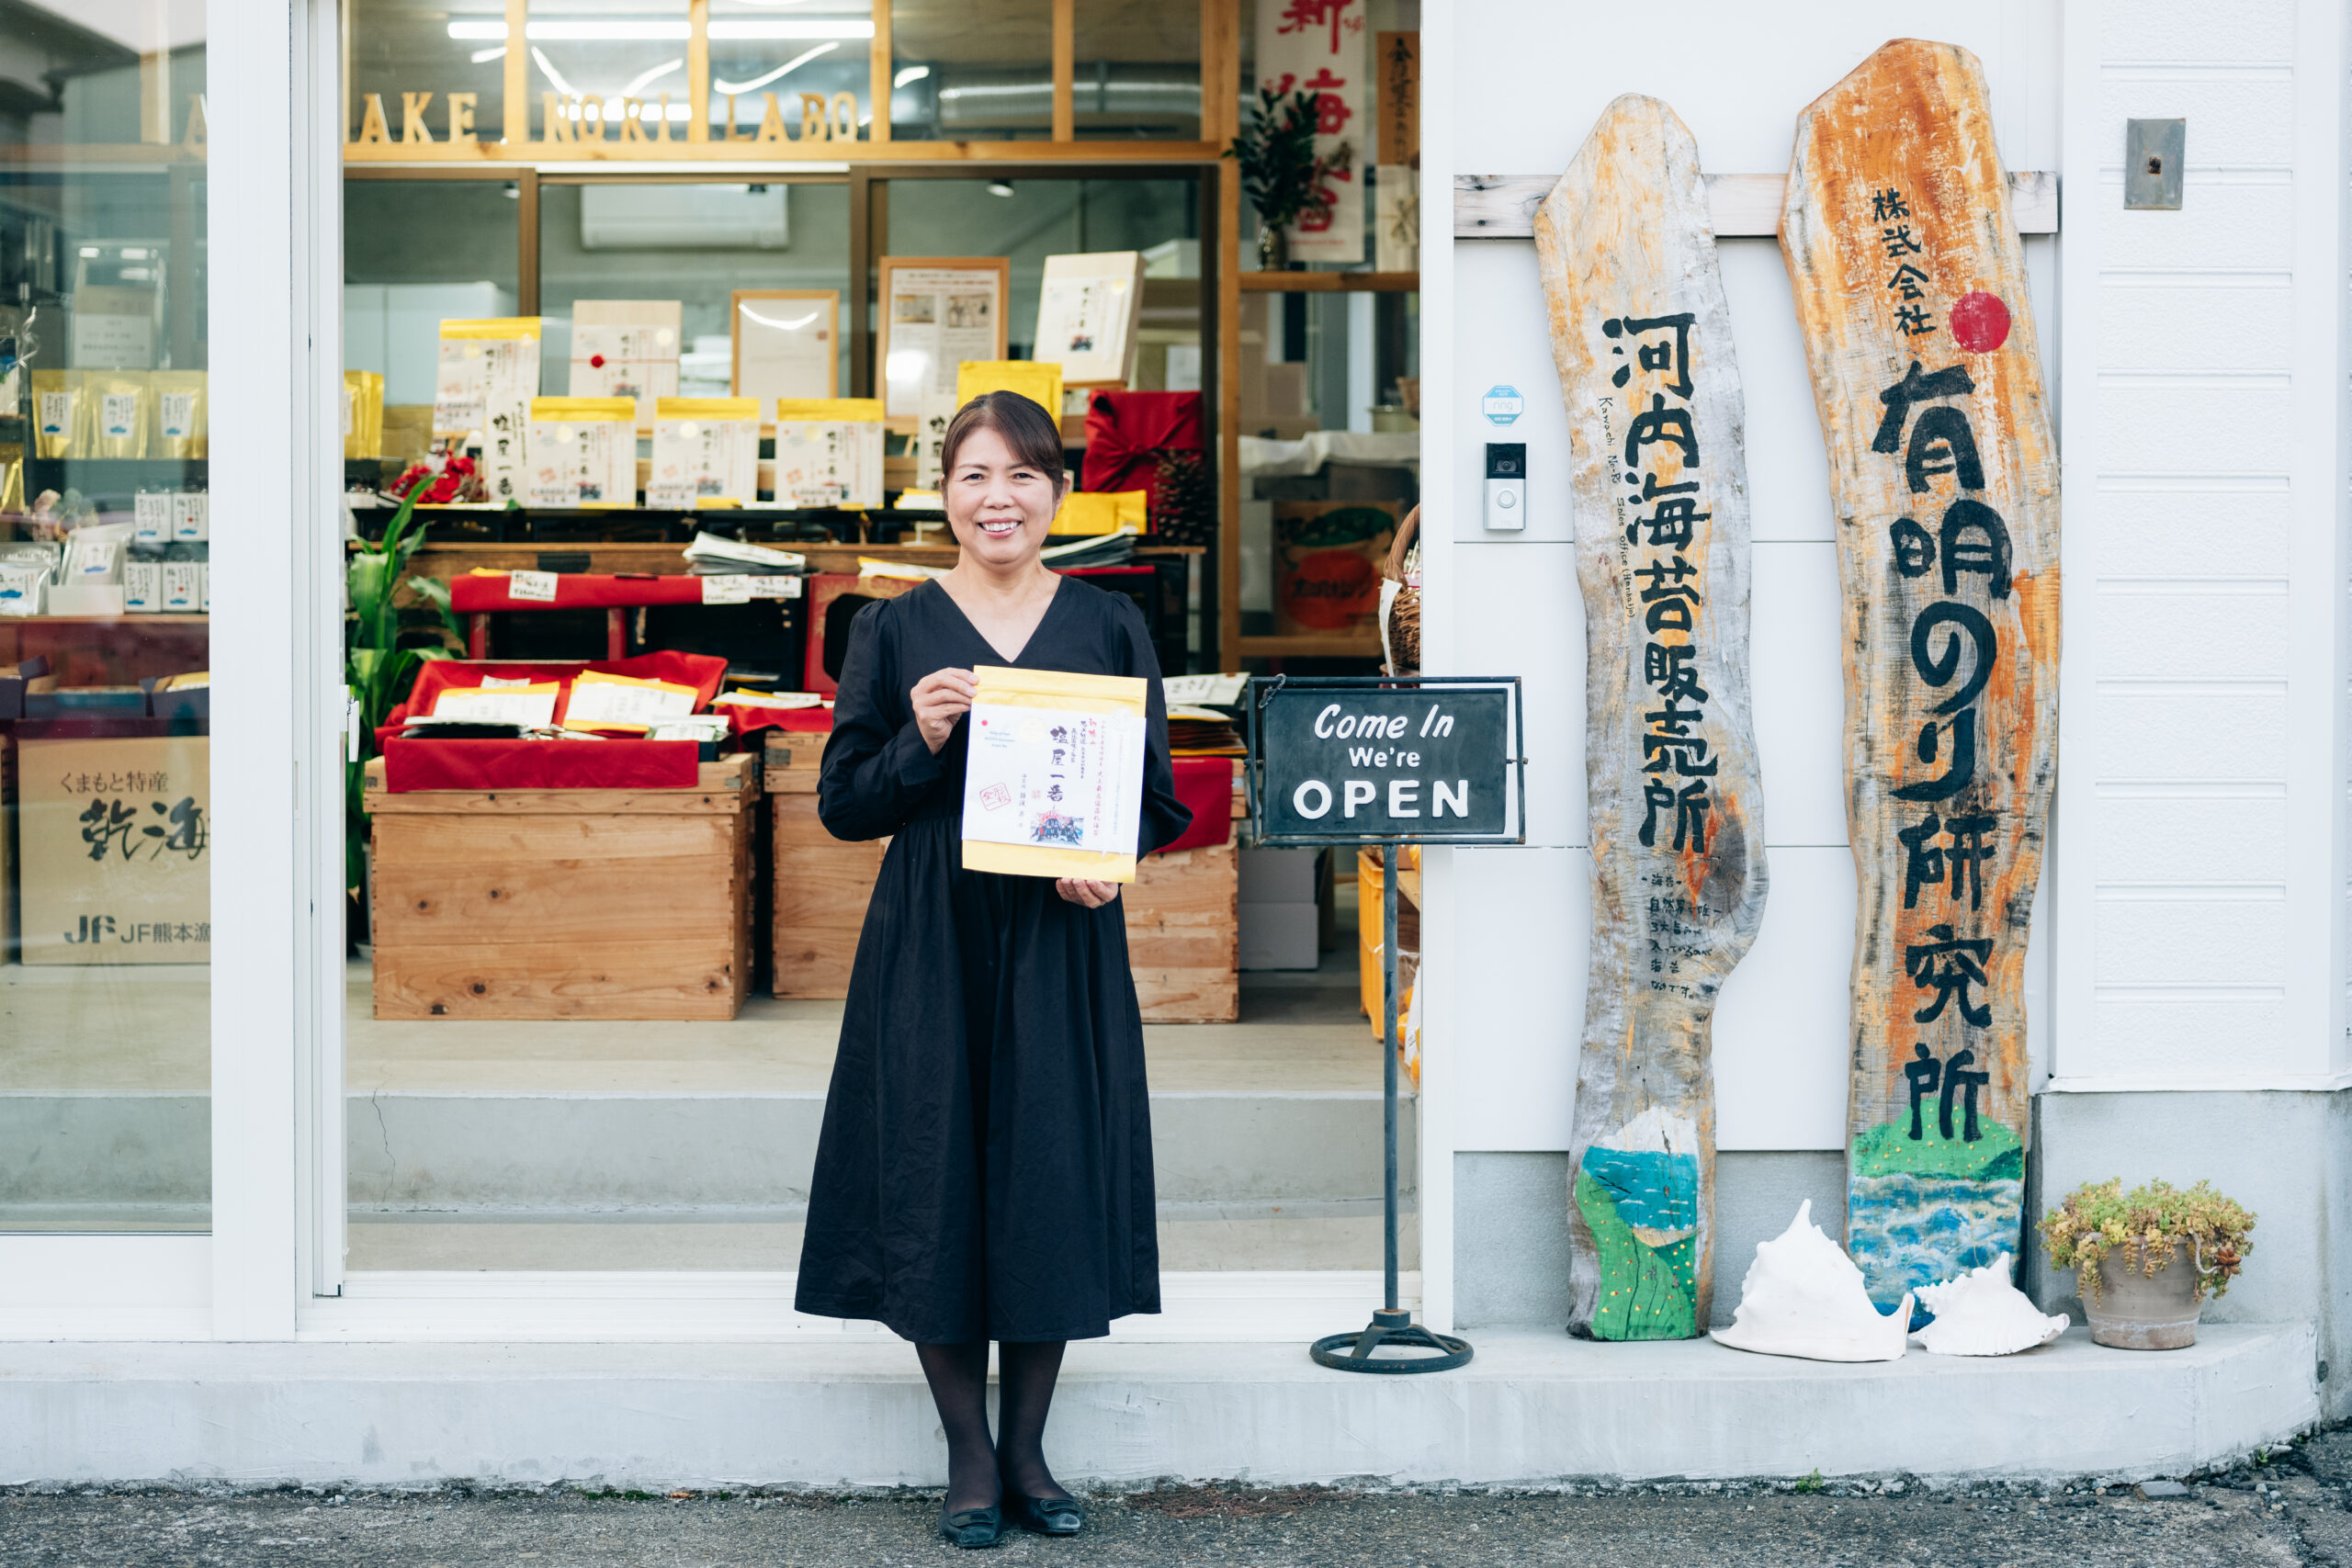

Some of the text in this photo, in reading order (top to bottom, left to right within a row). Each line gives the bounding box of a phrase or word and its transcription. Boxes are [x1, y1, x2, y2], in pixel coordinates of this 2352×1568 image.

[543, 92, 672, 142] NORI
[726, 92, 858, 142] LABO
[1871, 187, 1937, 338] 株式会社
[1599, 397, 1615, 446] Kawachi
[1617, 497, 1626, 527] Sales
[1620, 536, 1629, 567] office
[1601, 312, 1719, 854] 河内海苔販売所
[1314, 704, 1454, 739] Come In
[1348, 747, 1420, 768] We're
[1871, 359, 2013, 1143] 有明のり研究所
[60, 771, 169, 794] くまもと特産
[1293, 779, 1469, 820] OPEN
